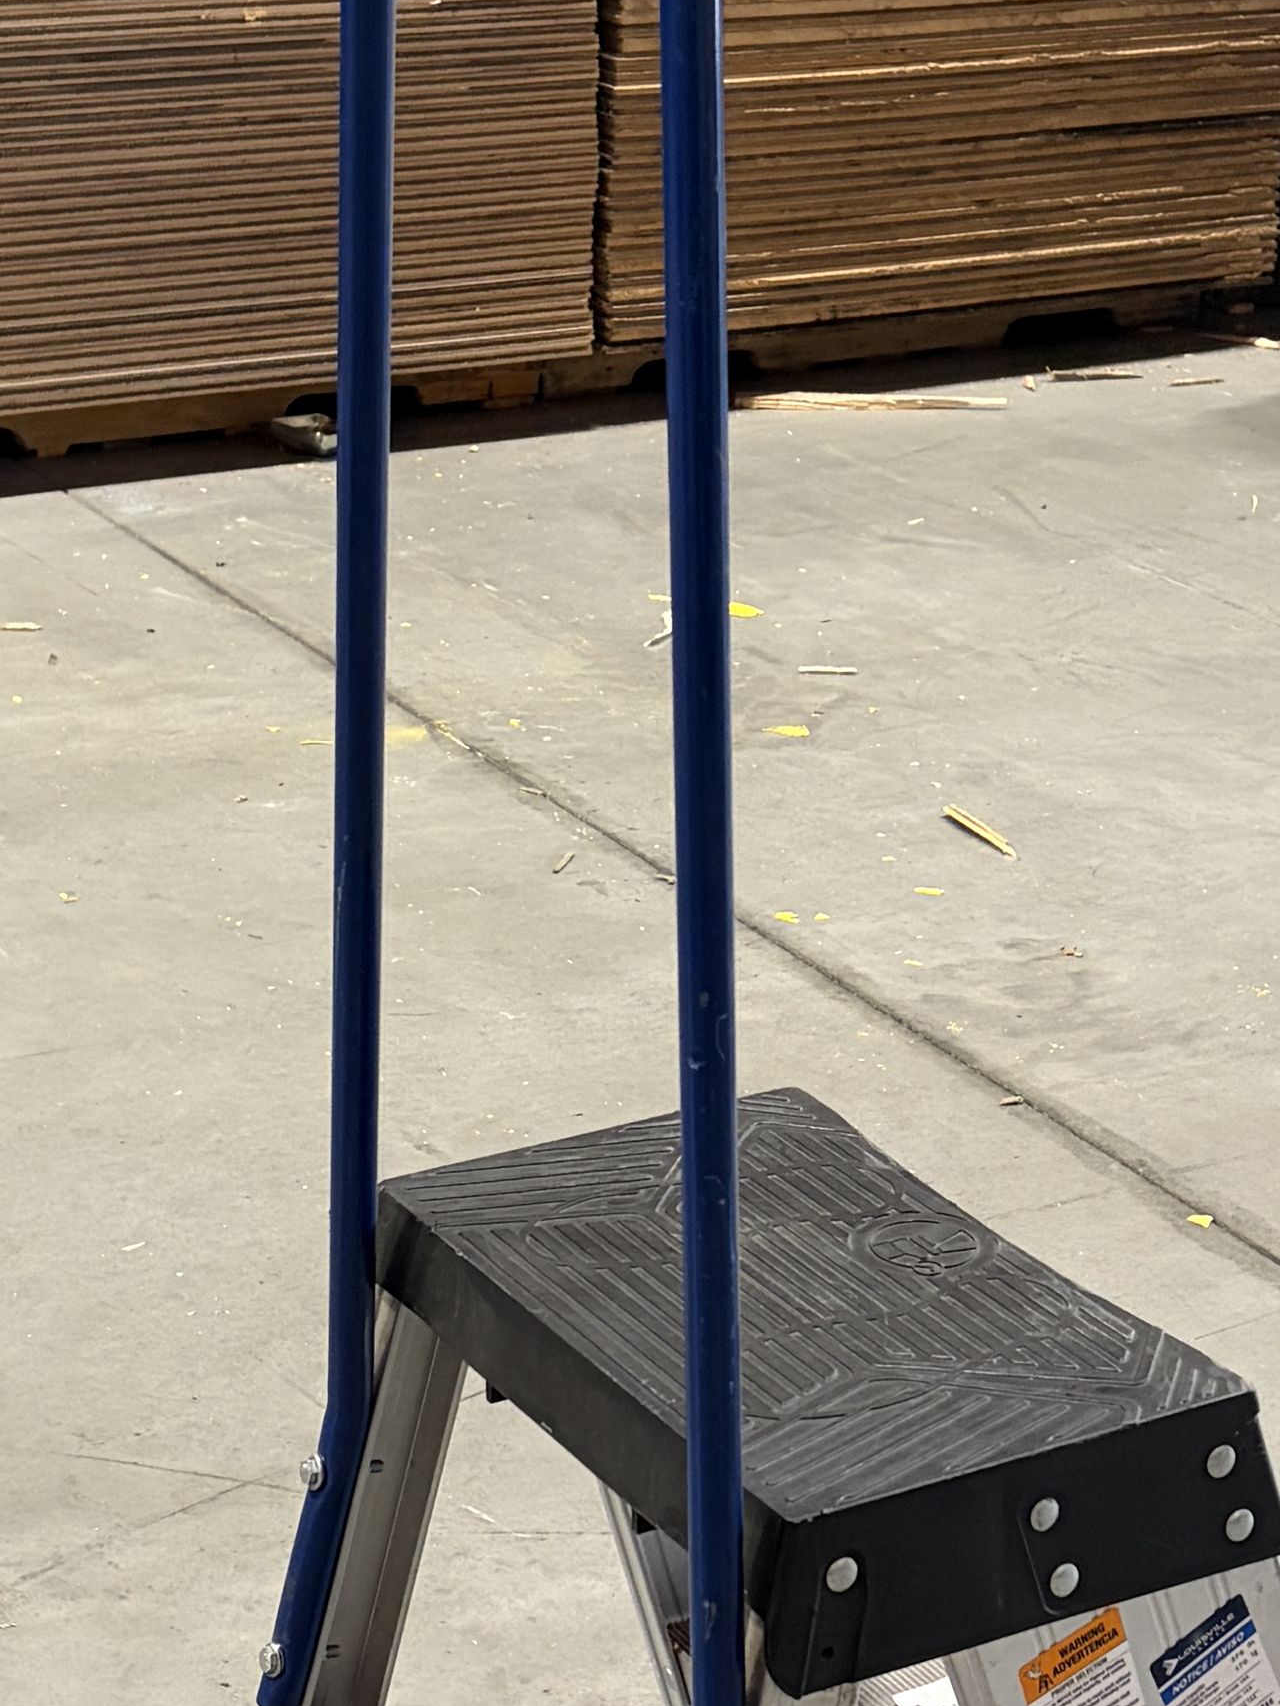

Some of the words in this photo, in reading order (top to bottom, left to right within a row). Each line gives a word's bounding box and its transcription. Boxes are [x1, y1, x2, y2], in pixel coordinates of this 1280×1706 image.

[1052, 1627, 1119, 1677] ADVERTENCIA
[1058, 1621, 1107, 1659] WARNING
[1177, 1612, 1235, 1661] LOUISVILLE
[1171, 1659, 1208, 1695] NOTICE
[1214, 1631, 1246, 1661] AVISO
